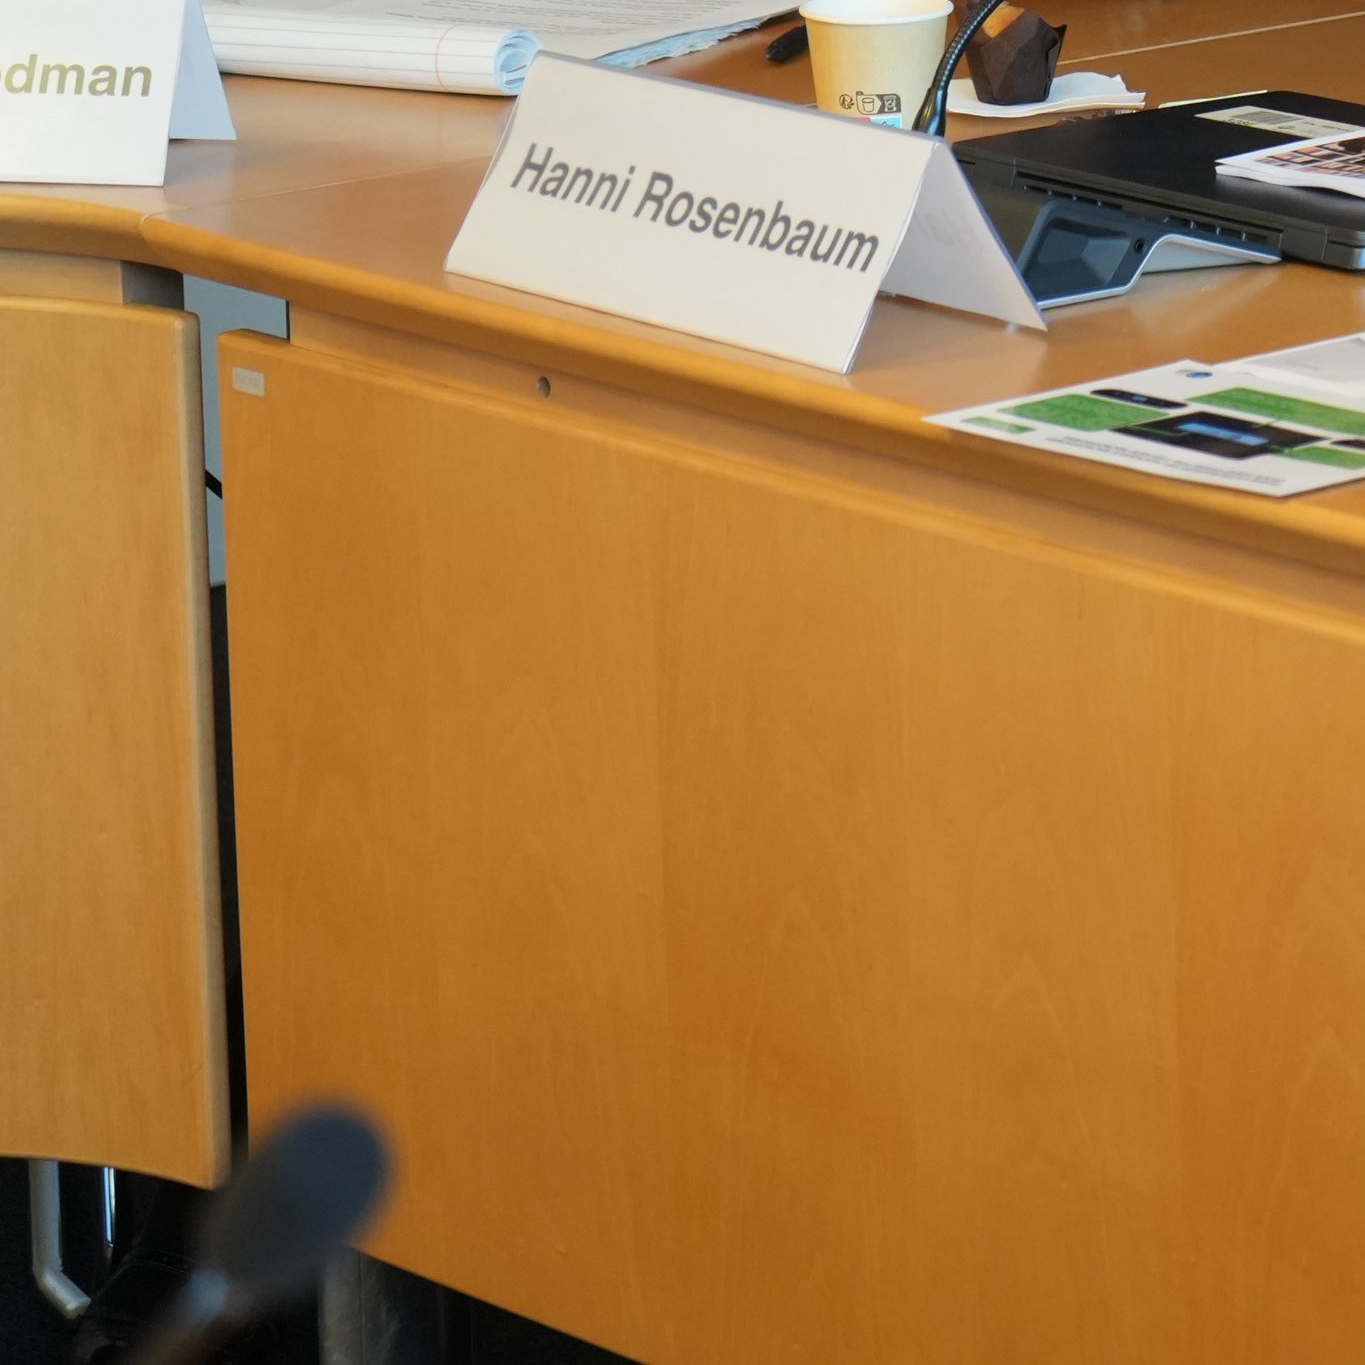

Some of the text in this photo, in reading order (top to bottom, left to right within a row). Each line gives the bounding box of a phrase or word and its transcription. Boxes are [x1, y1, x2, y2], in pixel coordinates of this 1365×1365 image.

[0, 53, 153, 97] dman
[510, 142, 881, 273] Hanni Rosenbaum
